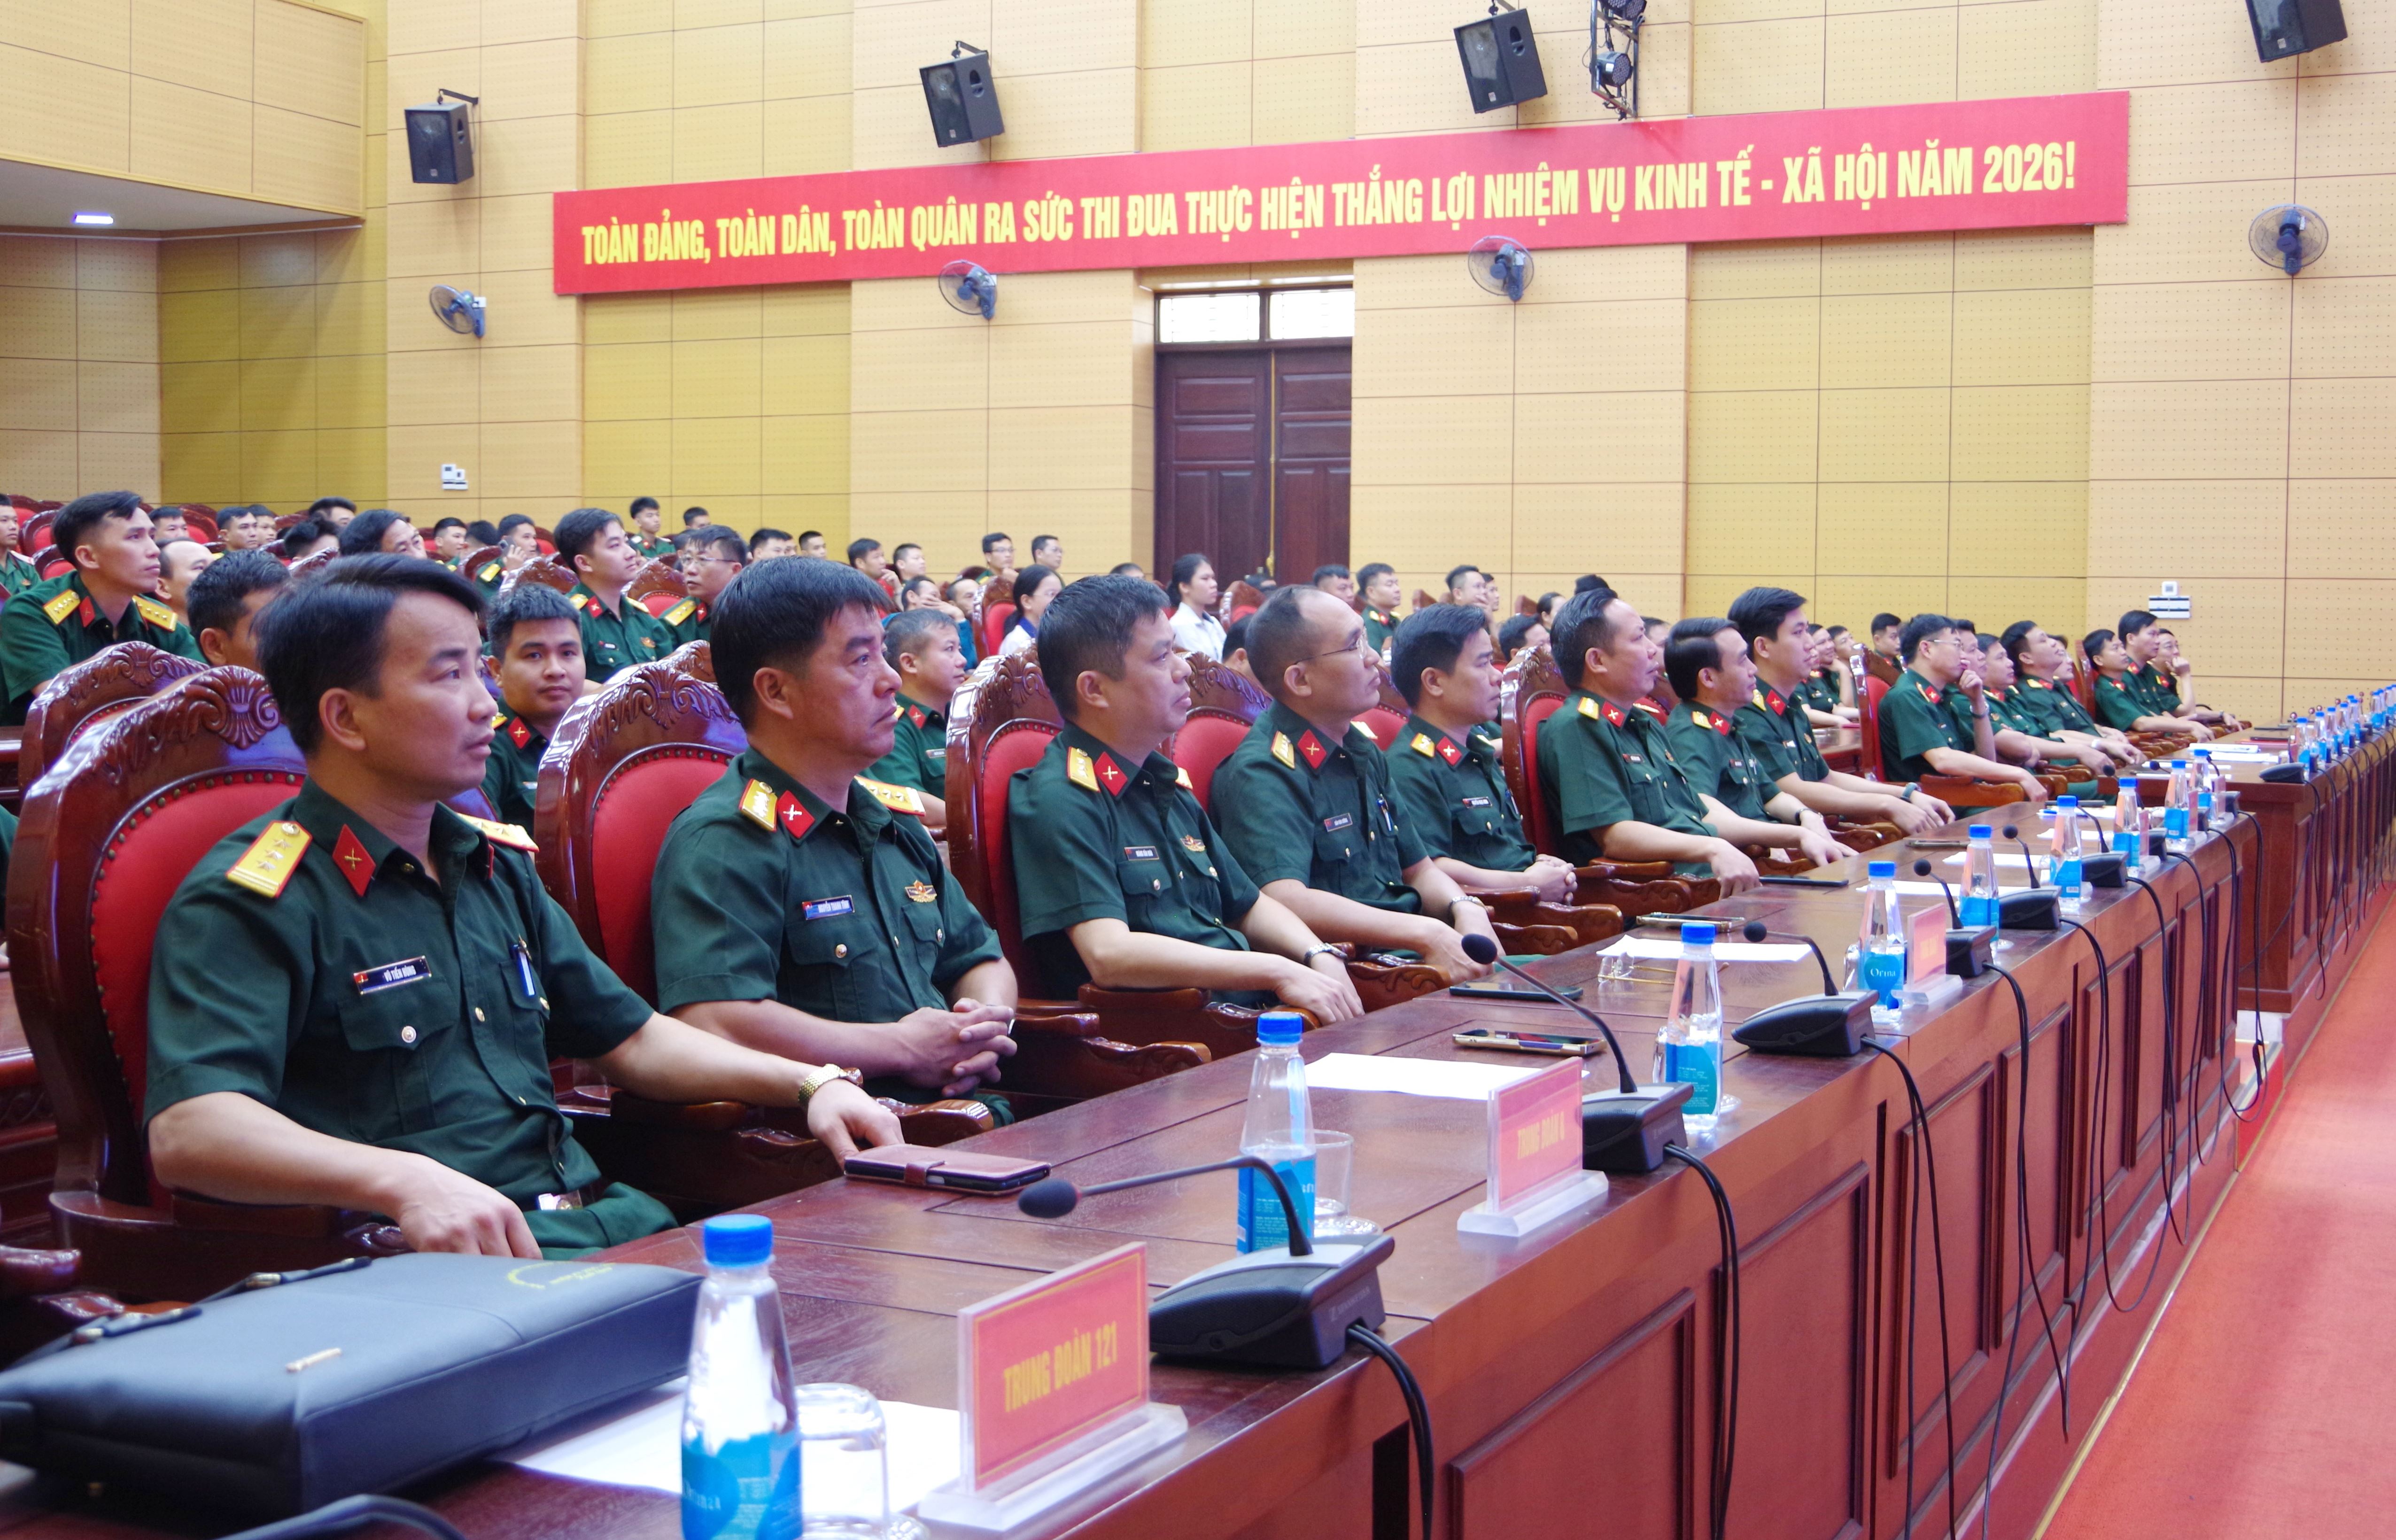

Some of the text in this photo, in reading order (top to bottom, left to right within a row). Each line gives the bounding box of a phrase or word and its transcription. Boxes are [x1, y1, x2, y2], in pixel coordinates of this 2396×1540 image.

[581, 216, 639, 265] TOÀN
[643, 208, 711, 264] ĐẢNG,
[715, 208, 776, 258] TOÀN
[781, 204, 837, 257] DÂN,
[841, 199, 905, 251] TOÀN
[910, 195, 978, 252] QUÂN
[983, 201, 1017, 244] RA
[1022, 190, 1074, 243] SỨC
[1079, 195, 1121, 240] THI
[1125, 192, 1179, 238] ĐUA
[1184, 184, 1254, 243] THỰC
[1259, 175, 1325, 240] HIỆN
[1330, 163, 1424, 227] THẮNG
[1430, 170, 1476, 232] LỢI
[1483, 161, 1580, 227] NHIỆM
[1587, 166, 1627, 223] VỤ
[1634, 161, 1708, 212] KINH
[1715, 143, 1755, 208] TẾ
[1781, 145, 1826, 204] XÃ
[1834, 142, 1888, 211] HỘI
[1897, 138, 1974, 198] NĂM
[1982, 140, 2076, 194] 2026!
[1095, 1320, 1118, 1370] 121
